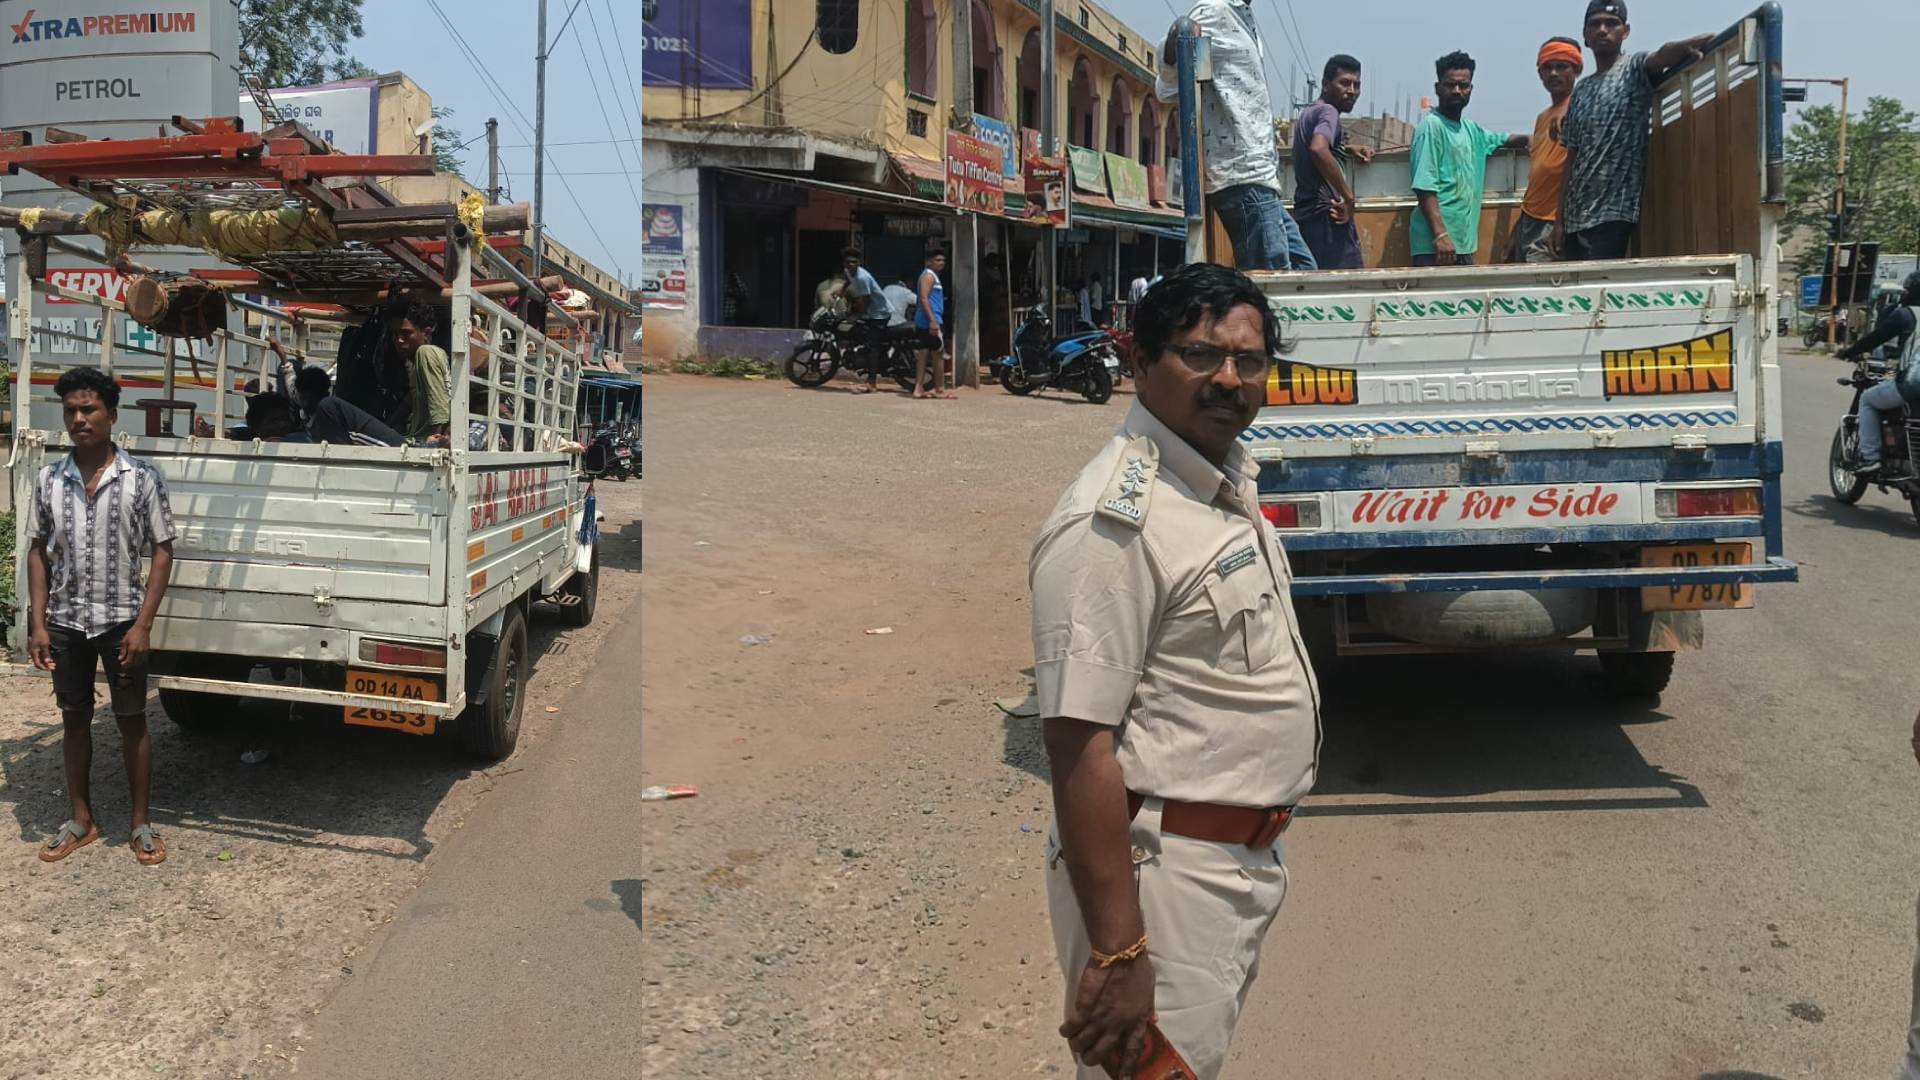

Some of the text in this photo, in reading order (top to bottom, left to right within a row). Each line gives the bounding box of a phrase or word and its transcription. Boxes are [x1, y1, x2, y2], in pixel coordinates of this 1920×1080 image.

[10, 9, 195, 44] XTRAPREMIUM
[55, 78, 141, 101] PETROL
[1604, 329, 1730, 395] HORN
[1352, 486, 1619, 523] Wait for Side
[354, 678, 423, 701] OD 14 AA
